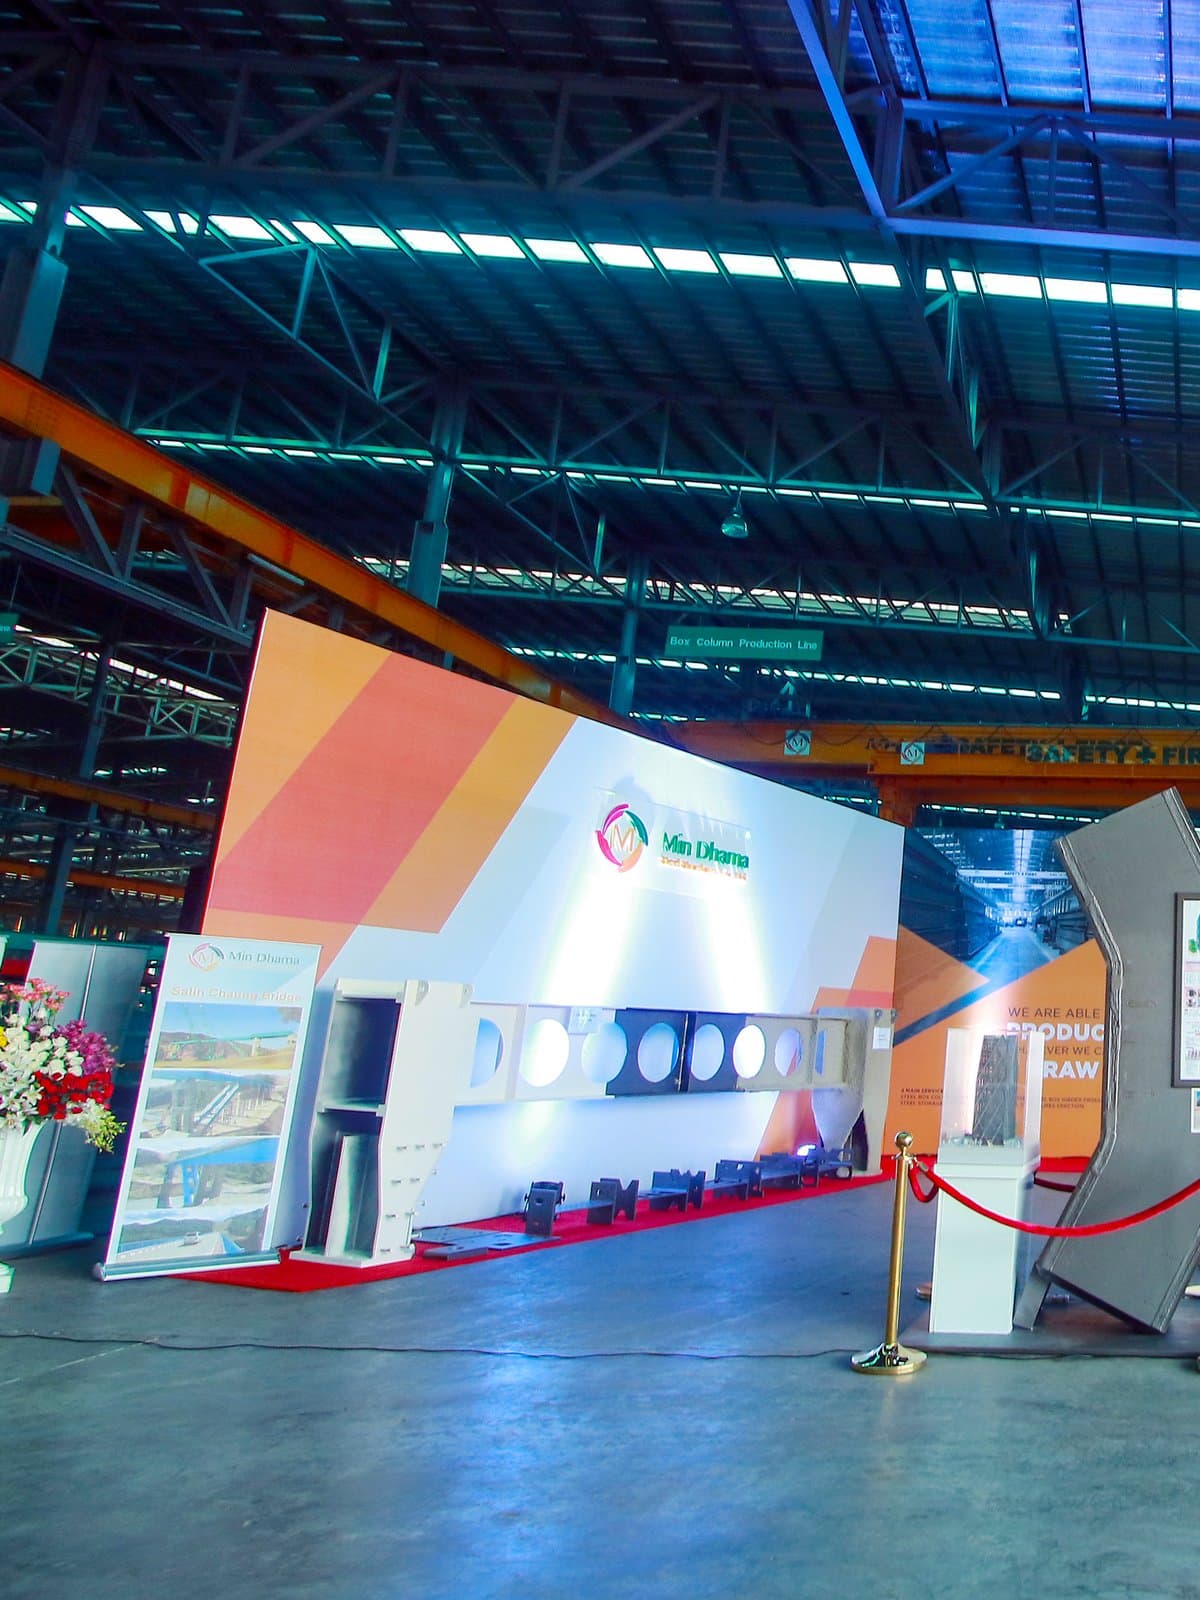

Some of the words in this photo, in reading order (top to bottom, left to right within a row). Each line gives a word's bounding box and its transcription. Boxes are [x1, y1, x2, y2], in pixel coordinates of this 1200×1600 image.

[669, 636, 690, 647] Box
[696, 637, 734, 648] Column
[738, 638, 793, 650] Production
[796, 640, 819, 651] Line
[1026, 743, 1128, 764] SAFETY
[662, 831, 693, 857] Min
[695, 840, 749, 869] Dhama
[1008, 1007, 1030, 1017] WE
[1034, 1007, 1061, 1018] ARE
[1065, 1008, 1101, 1019] ABLE
[1072, 1047, 1090, 1056] WE
[1042, 1060, 1100, 1080] RAW
